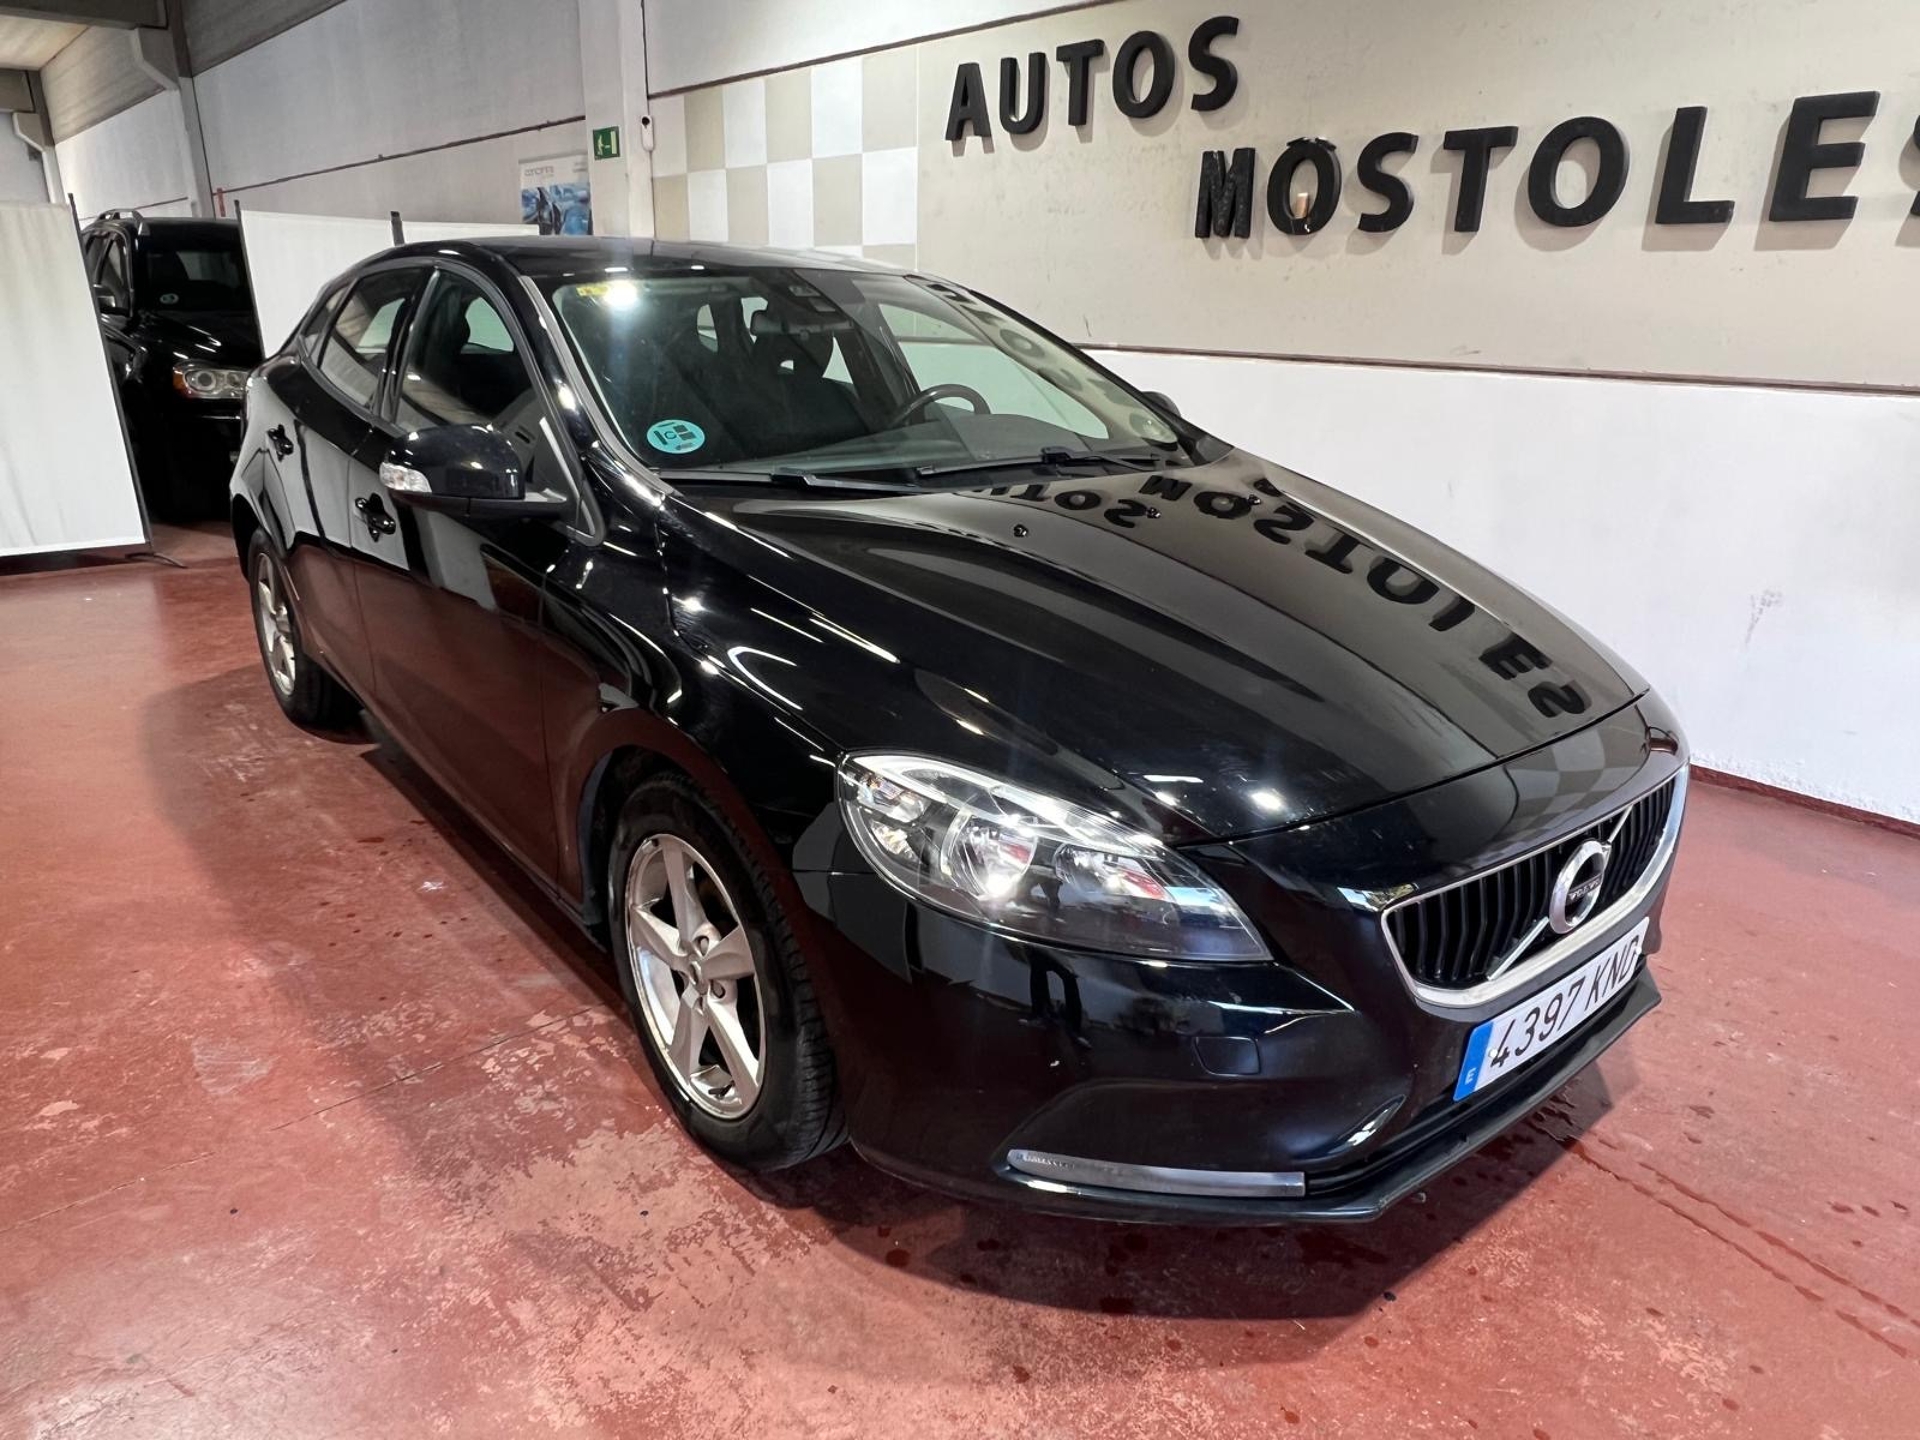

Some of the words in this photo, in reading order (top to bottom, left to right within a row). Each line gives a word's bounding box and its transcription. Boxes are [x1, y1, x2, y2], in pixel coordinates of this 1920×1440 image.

[945, 16, 1240, 142] AUTOS
[1194, 91, 1920, 239] MOSTOLE
[1489, 976, 1587, 1068] 4397
[1584, 934, 1640, 1012] KND
